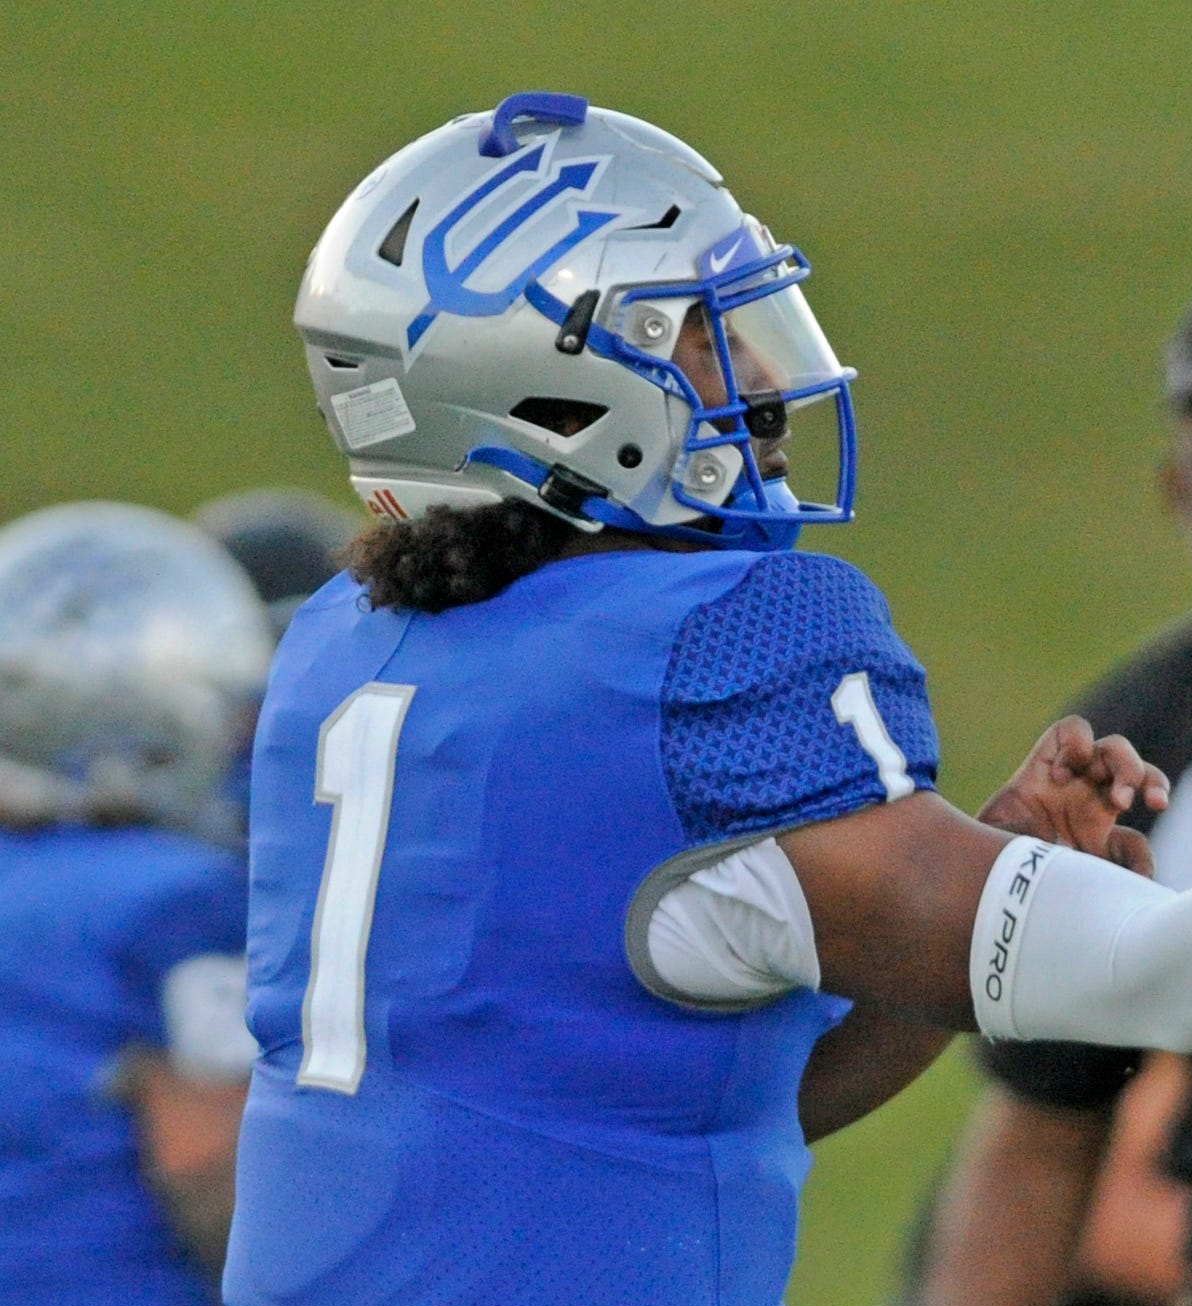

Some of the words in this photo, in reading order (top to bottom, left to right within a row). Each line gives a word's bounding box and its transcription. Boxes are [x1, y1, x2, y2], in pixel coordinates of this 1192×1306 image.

[831, 671, 915, 803] 1
[296, 681, 417, 1095] 1
[985, 907, 1017, 1002] PRO
